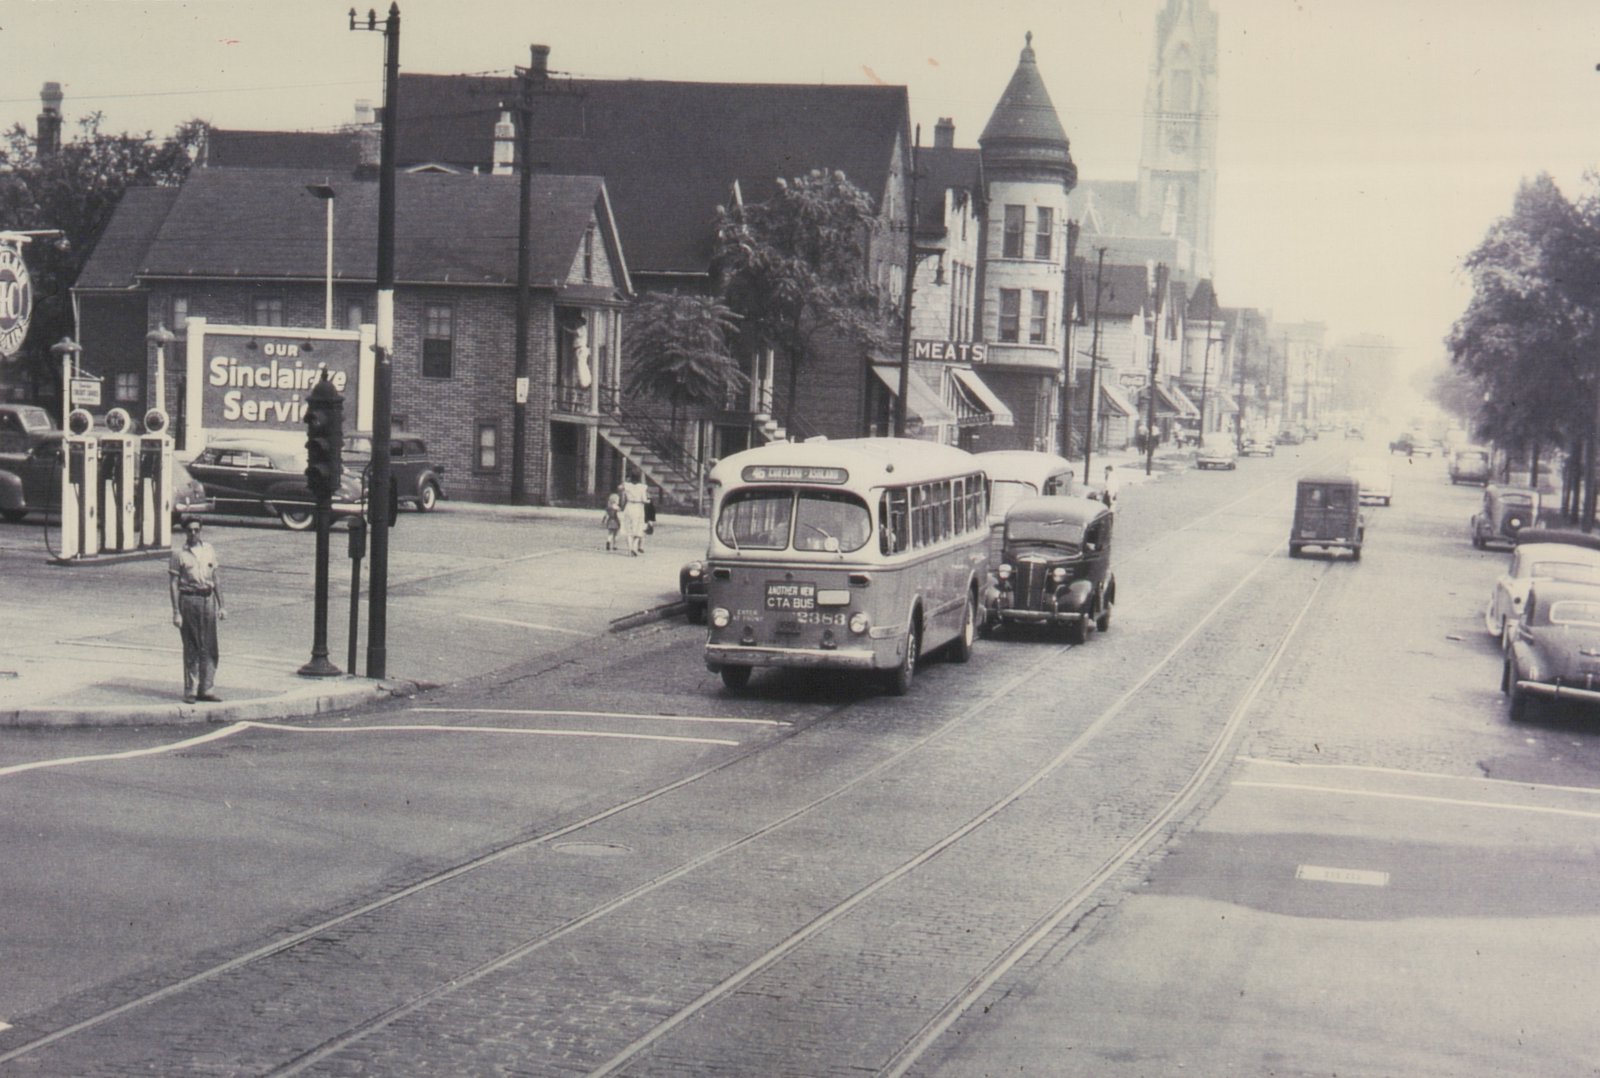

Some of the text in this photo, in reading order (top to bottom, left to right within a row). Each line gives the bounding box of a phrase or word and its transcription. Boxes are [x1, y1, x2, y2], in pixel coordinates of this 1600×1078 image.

[264, 342, 299, 357] OUR
[915, 342, 984, 361] MEATS
[767, 585, 798, 596] ANOTHER
[767, 597, 815, 609] CTA BUS
